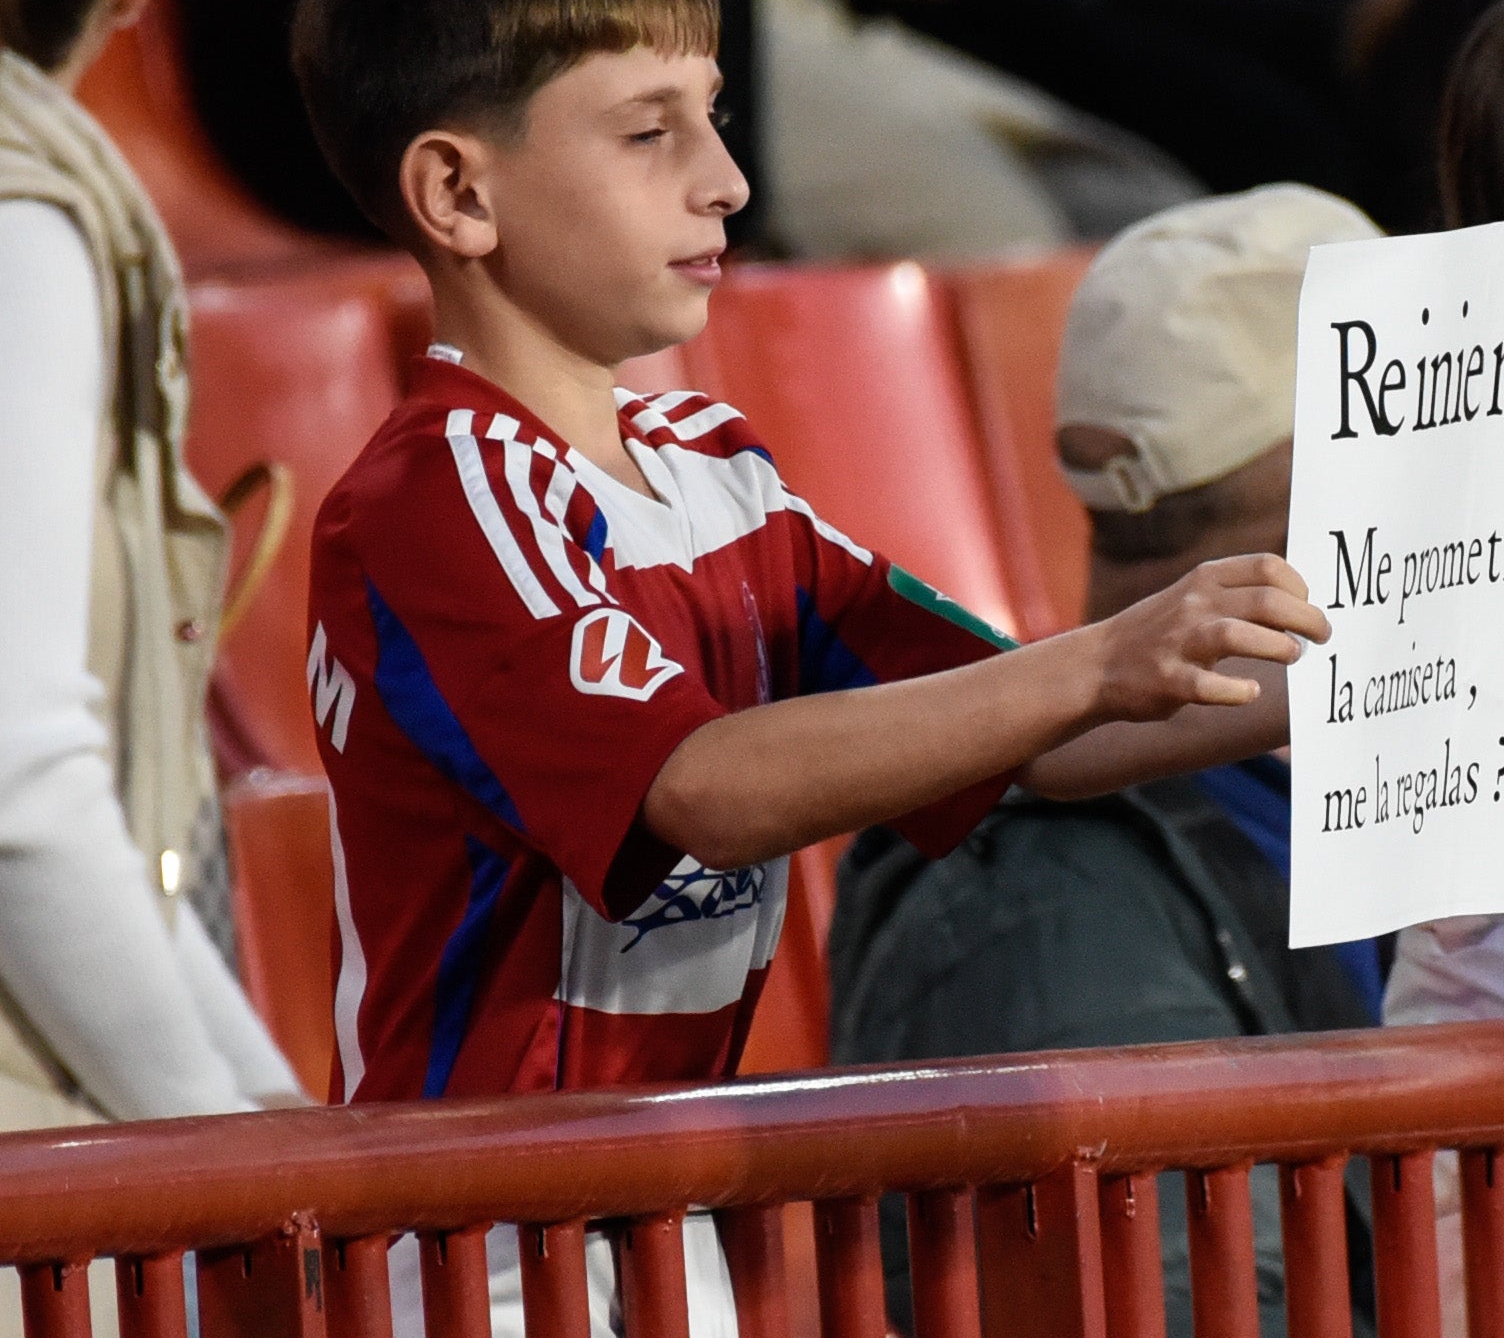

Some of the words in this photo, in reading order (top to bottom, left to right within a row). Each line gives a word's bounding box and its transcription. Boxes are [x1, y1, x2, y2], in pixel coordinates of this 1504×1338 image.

[1327, 526, 1391, 610] Me
[1326, 653, 1354, 724] la
[1363, 642, 1457, 719] camiseta
[1322, 785, 1366, 833] me
[1374, 755, 1390, 824] la
[1395, 739, 1480, 835] regalas
